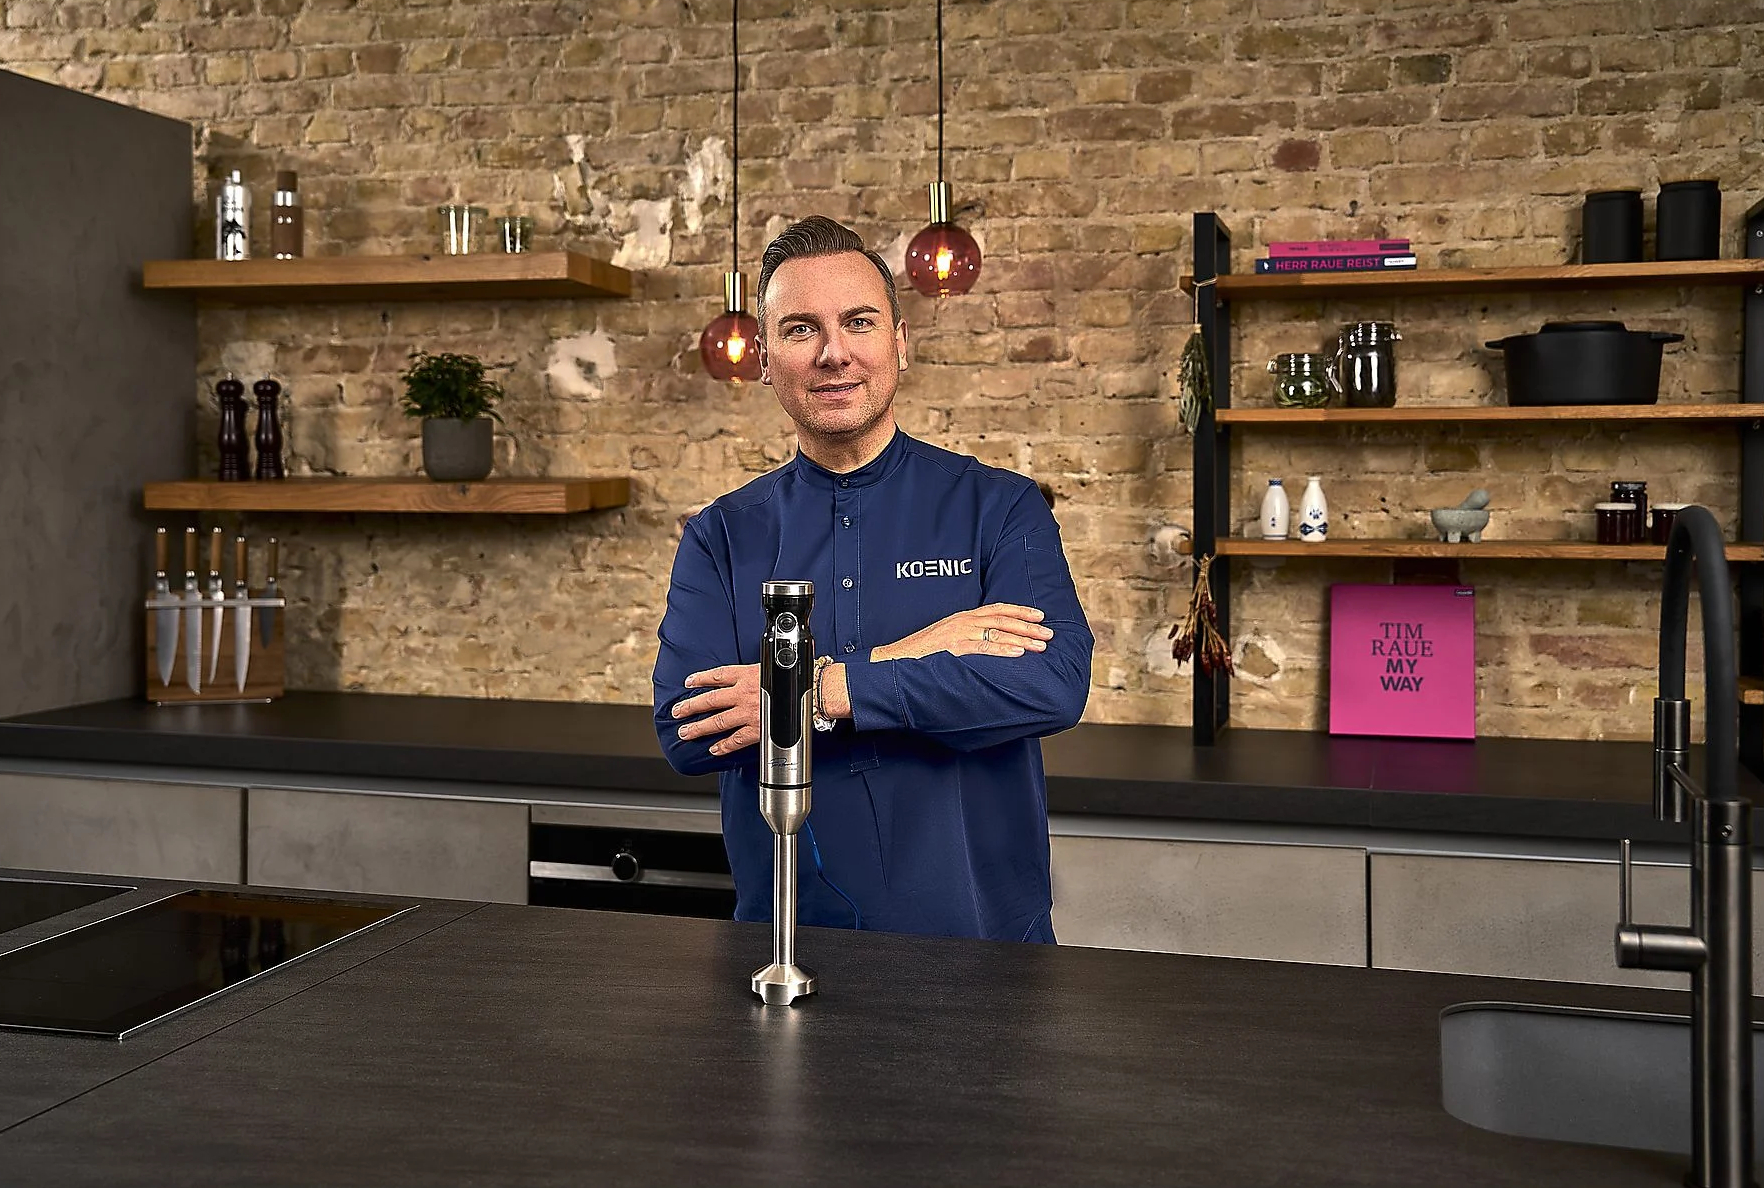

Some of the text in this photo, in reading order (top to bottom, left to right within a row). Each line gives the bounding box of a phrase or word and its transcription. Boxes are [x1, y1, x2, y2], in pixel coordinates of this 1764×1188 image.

[1275, 261, 1308, 271] HERR
[1311, 259, 1343, 270] RAUE
[1346, 258, 1380, 268] REIST
[896, 558, 972, 579] KOENIC
[1379, 622, 1423, 640] TIM
[1371, 640, 1434, 657] RAUE
[1385, 658, 1418, 674] MY
[1380, 676, 1424, 692] WAY
